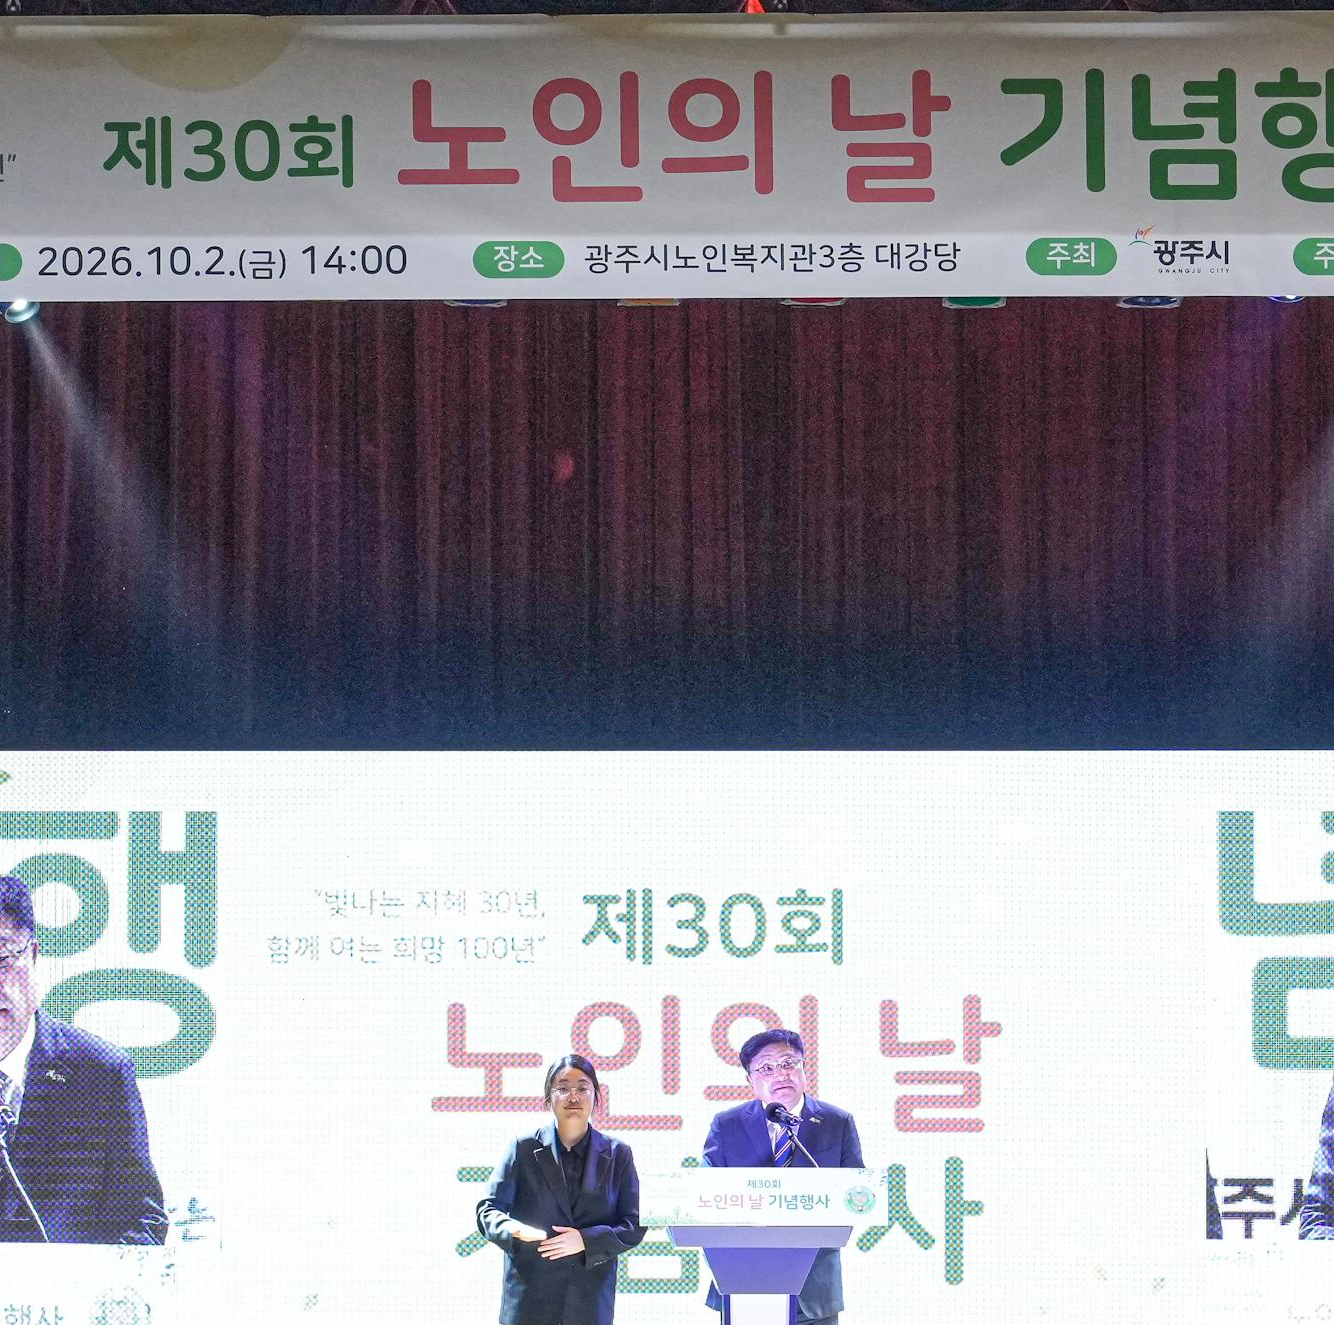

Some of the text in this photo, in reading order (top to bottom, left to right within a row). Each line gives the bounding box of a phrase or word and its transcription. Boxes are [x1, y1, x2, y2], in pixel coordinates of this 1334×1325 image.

[102, 114, 355, 190] 제30회
[397, 70, 775, 203] 노인의
[830, 68, 952, 203] 날
[37, 245, 408, 281] 2026.10.2.(금) 14:00
[492, 245, 546, 274] 장소
[583, 239, 963, 275] 광주시노인복지관3층 대강당
[1046, 241, 1097, 269] 주최
[1153, 240, 1229, 266] 광주시
[417, 888, 467, 916] 지혜
[478, 888, 546, 918] 30년,
[581, 886, 845, 966] 제30회
[267, 935, 319, 964] 함께
[329, 935, 383, 964] 여는
[393, 935, 446, 964] 희망
[879, 994, 1003, 1133] 날
[747, 1178, 782, 1190] 제30회
[698, 1193, 831, 1211] 노인의 날 기념행사
